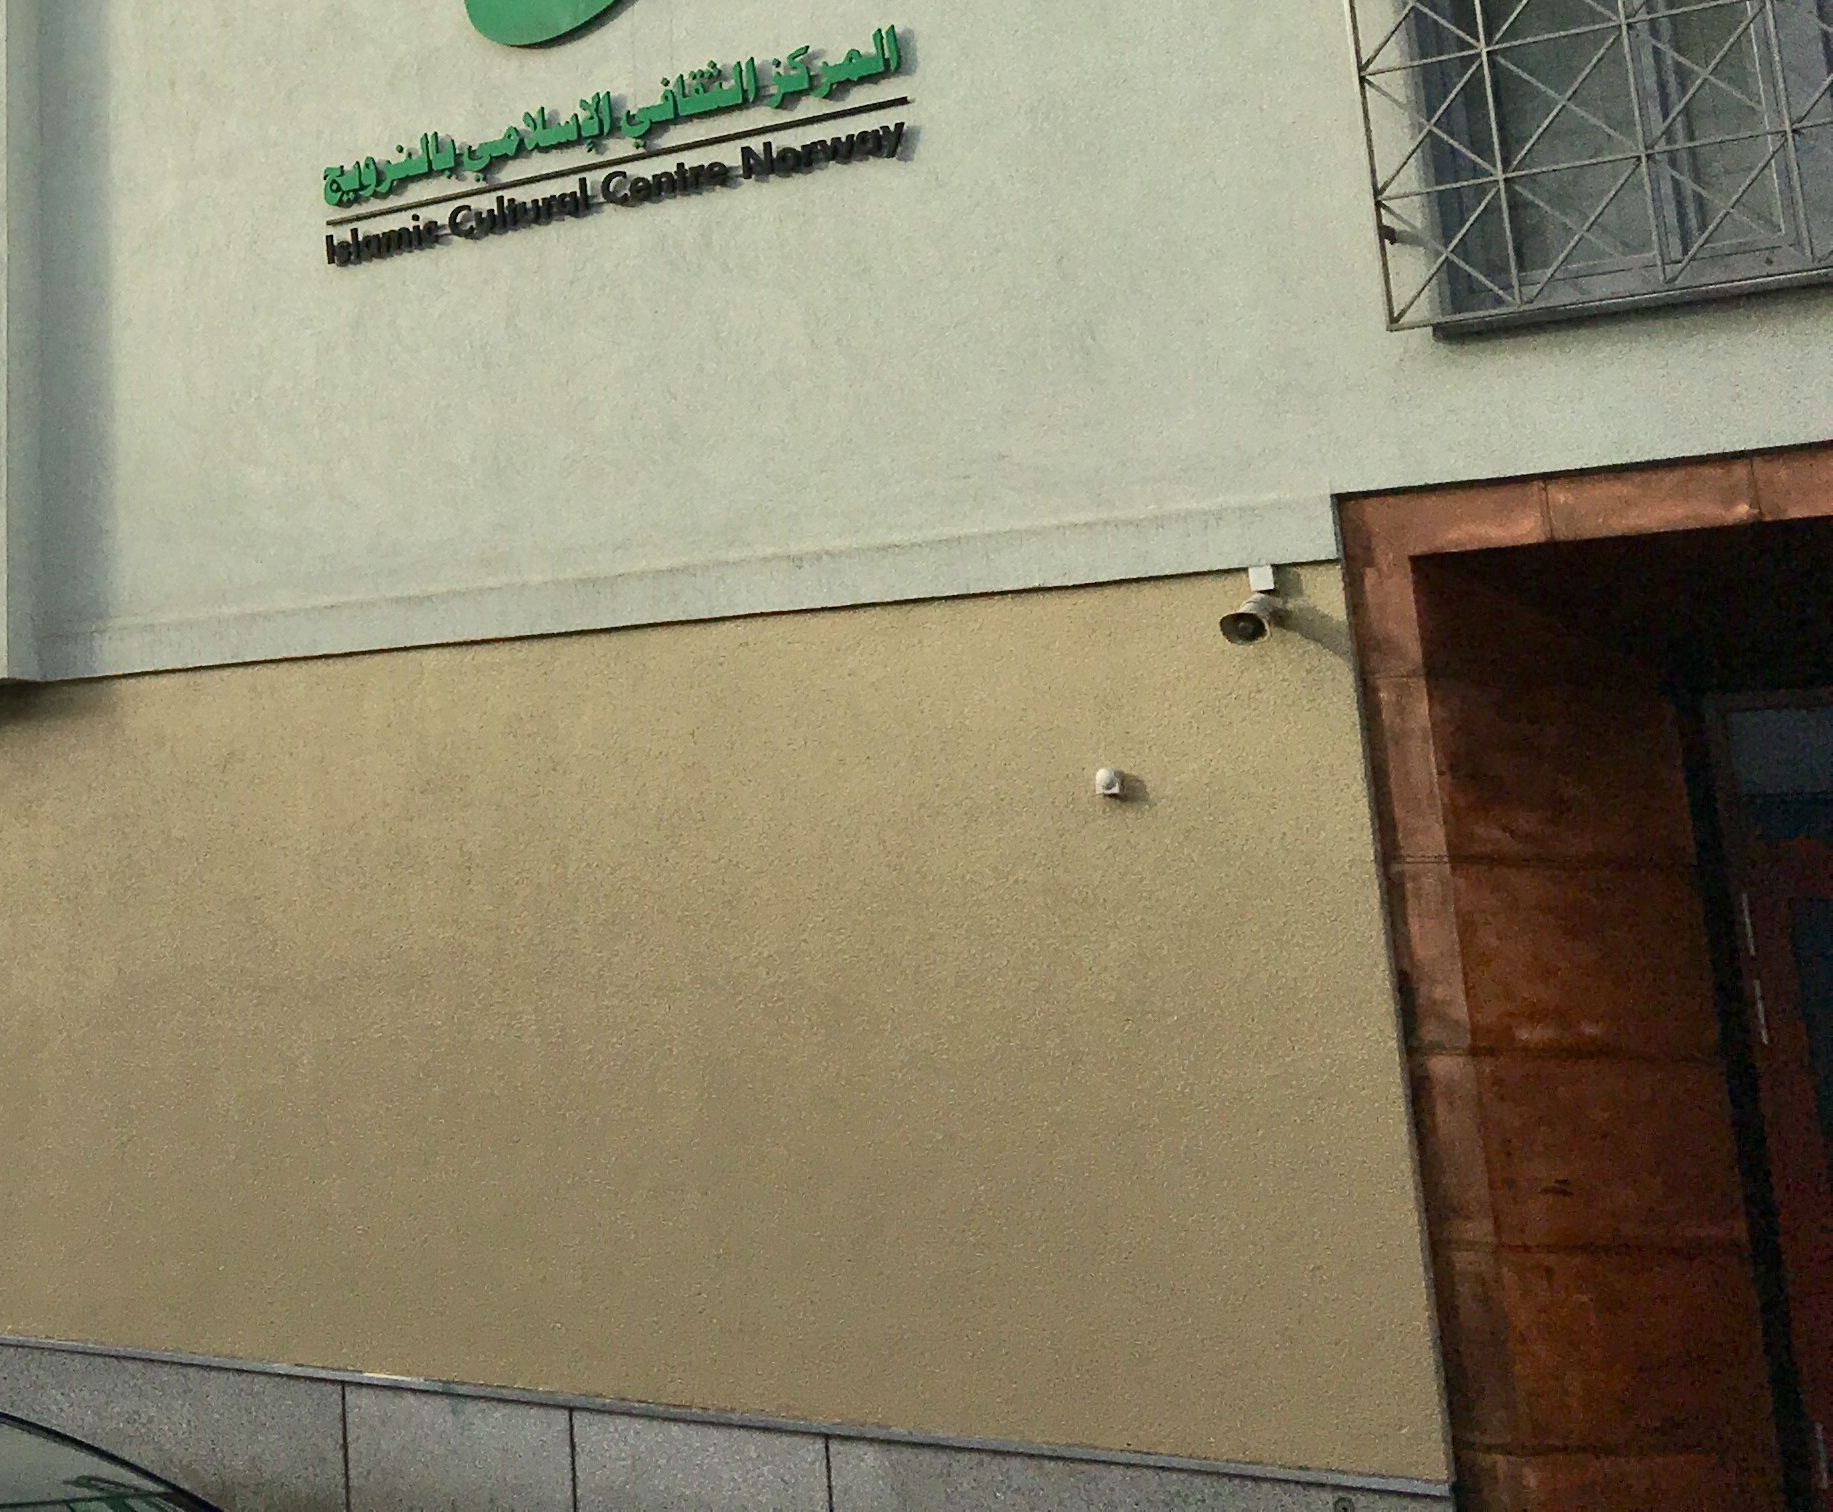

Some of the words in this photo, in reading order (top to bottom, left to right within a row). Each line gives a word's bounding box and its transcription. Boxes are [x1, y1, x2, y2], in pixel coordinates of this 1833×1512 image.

[621, 56, 757, 149] الثقافي
[767, 24, 902, 109] المركز
[324, 131, 455, 206] بالنرويج
[325, 214, 440, 267] Islamic
[448, 177, 591, 240] Cultural
[600, 162, 729, 205] Centre
[741, 122, 905, 180] Norway
